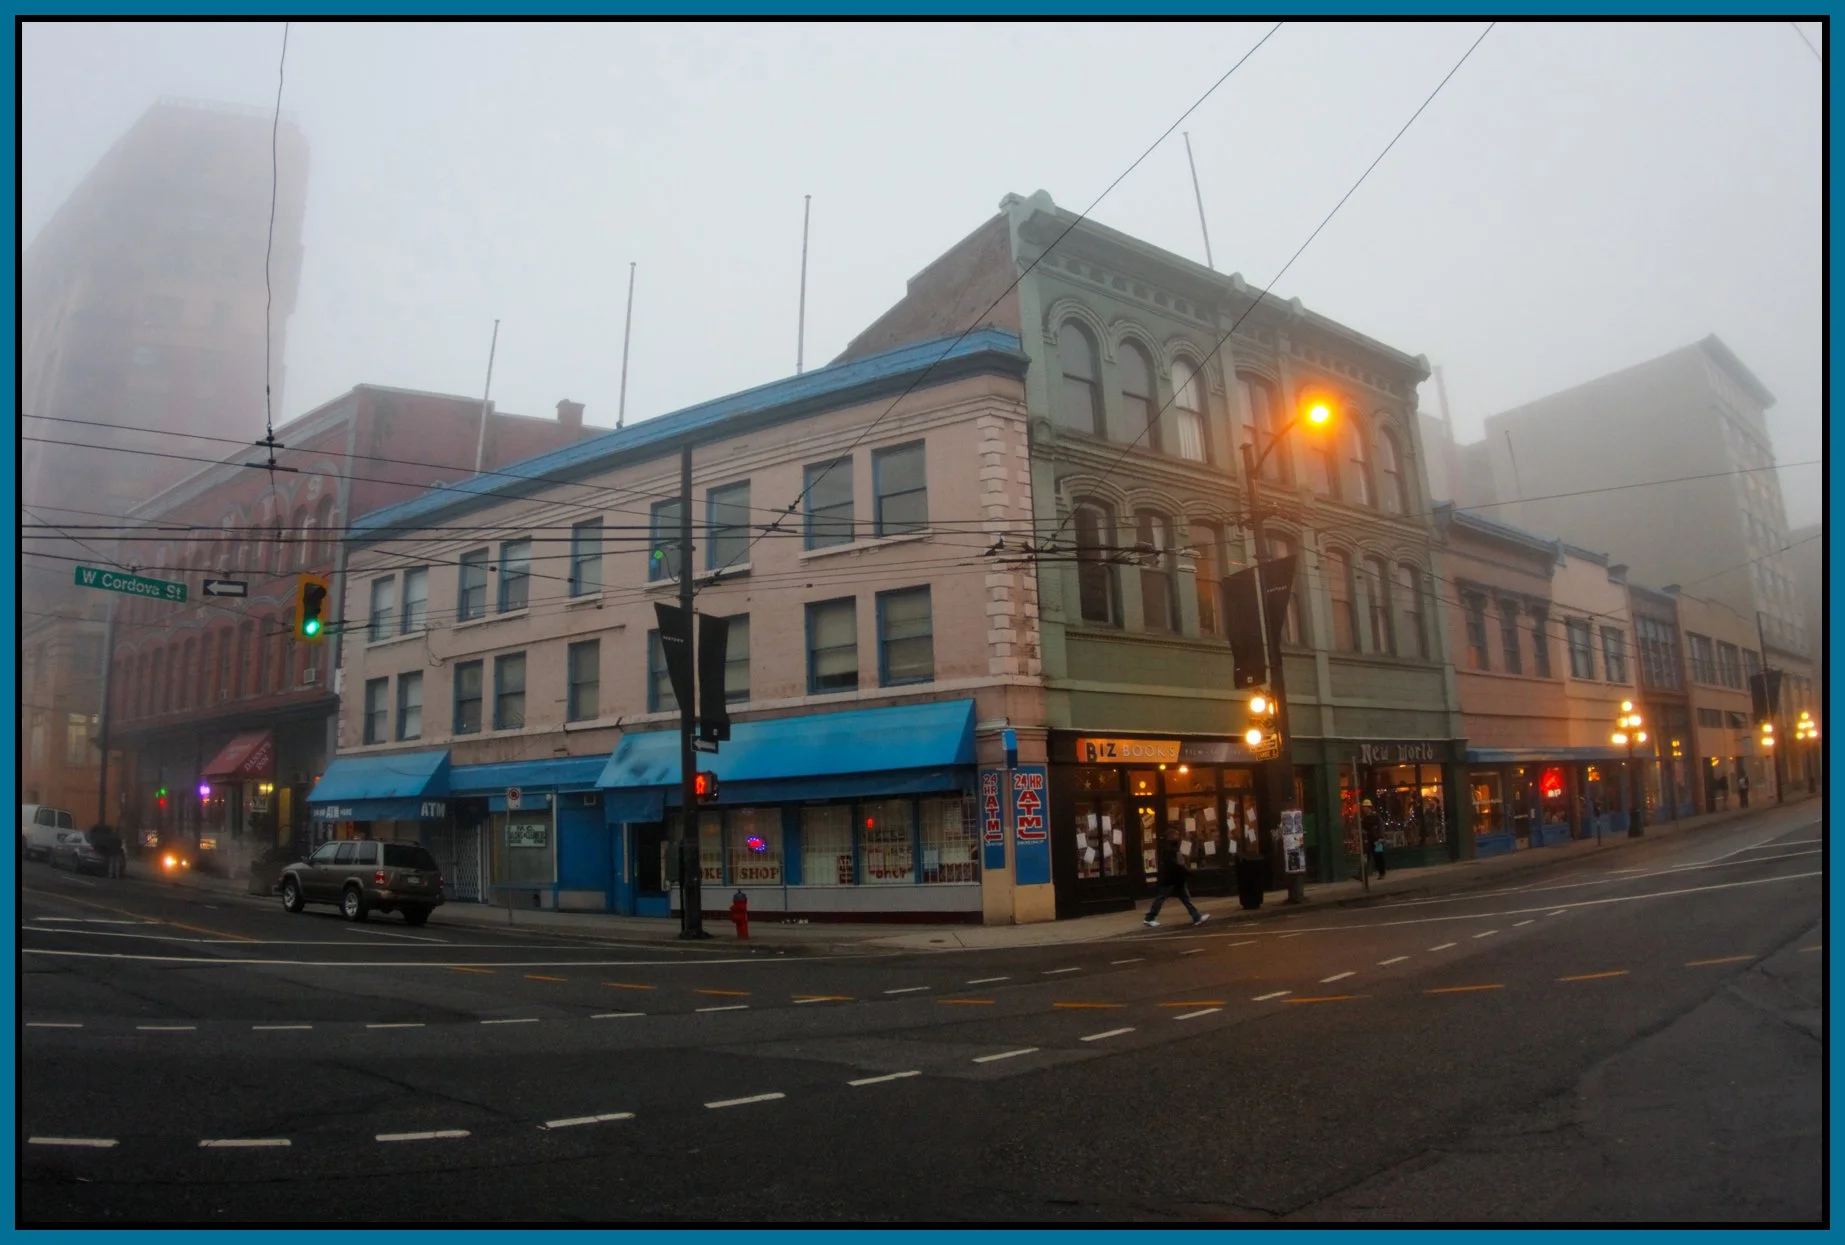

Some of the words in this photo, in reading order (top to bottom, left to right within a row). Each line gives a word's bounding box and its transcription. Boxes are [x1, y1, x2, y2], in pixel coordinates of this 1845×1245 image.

[82, 569, 97, 584] W
[101, 573, 160, 596] Cordova
[166, 584, 182, 600] St
[1086, 742, 1117, 762] BIZ
[1122, 744, 1176, 759] BOOKS
[1360, 743, 1389, 767] New
[1397, 742, 1433, 763] World
[983, 773, 998, 785] 24
[1014, 773, 1028, 789] 24
[1029, 773, 1043, 789] HR
[983, 785, 998, 795] HR
[420, 802, 446, 819] ATM
[985, 795, 1001, 832] ATM
[1017, 789, 1043, 828] ATM
[739, 866, 780, 880] SHOP
